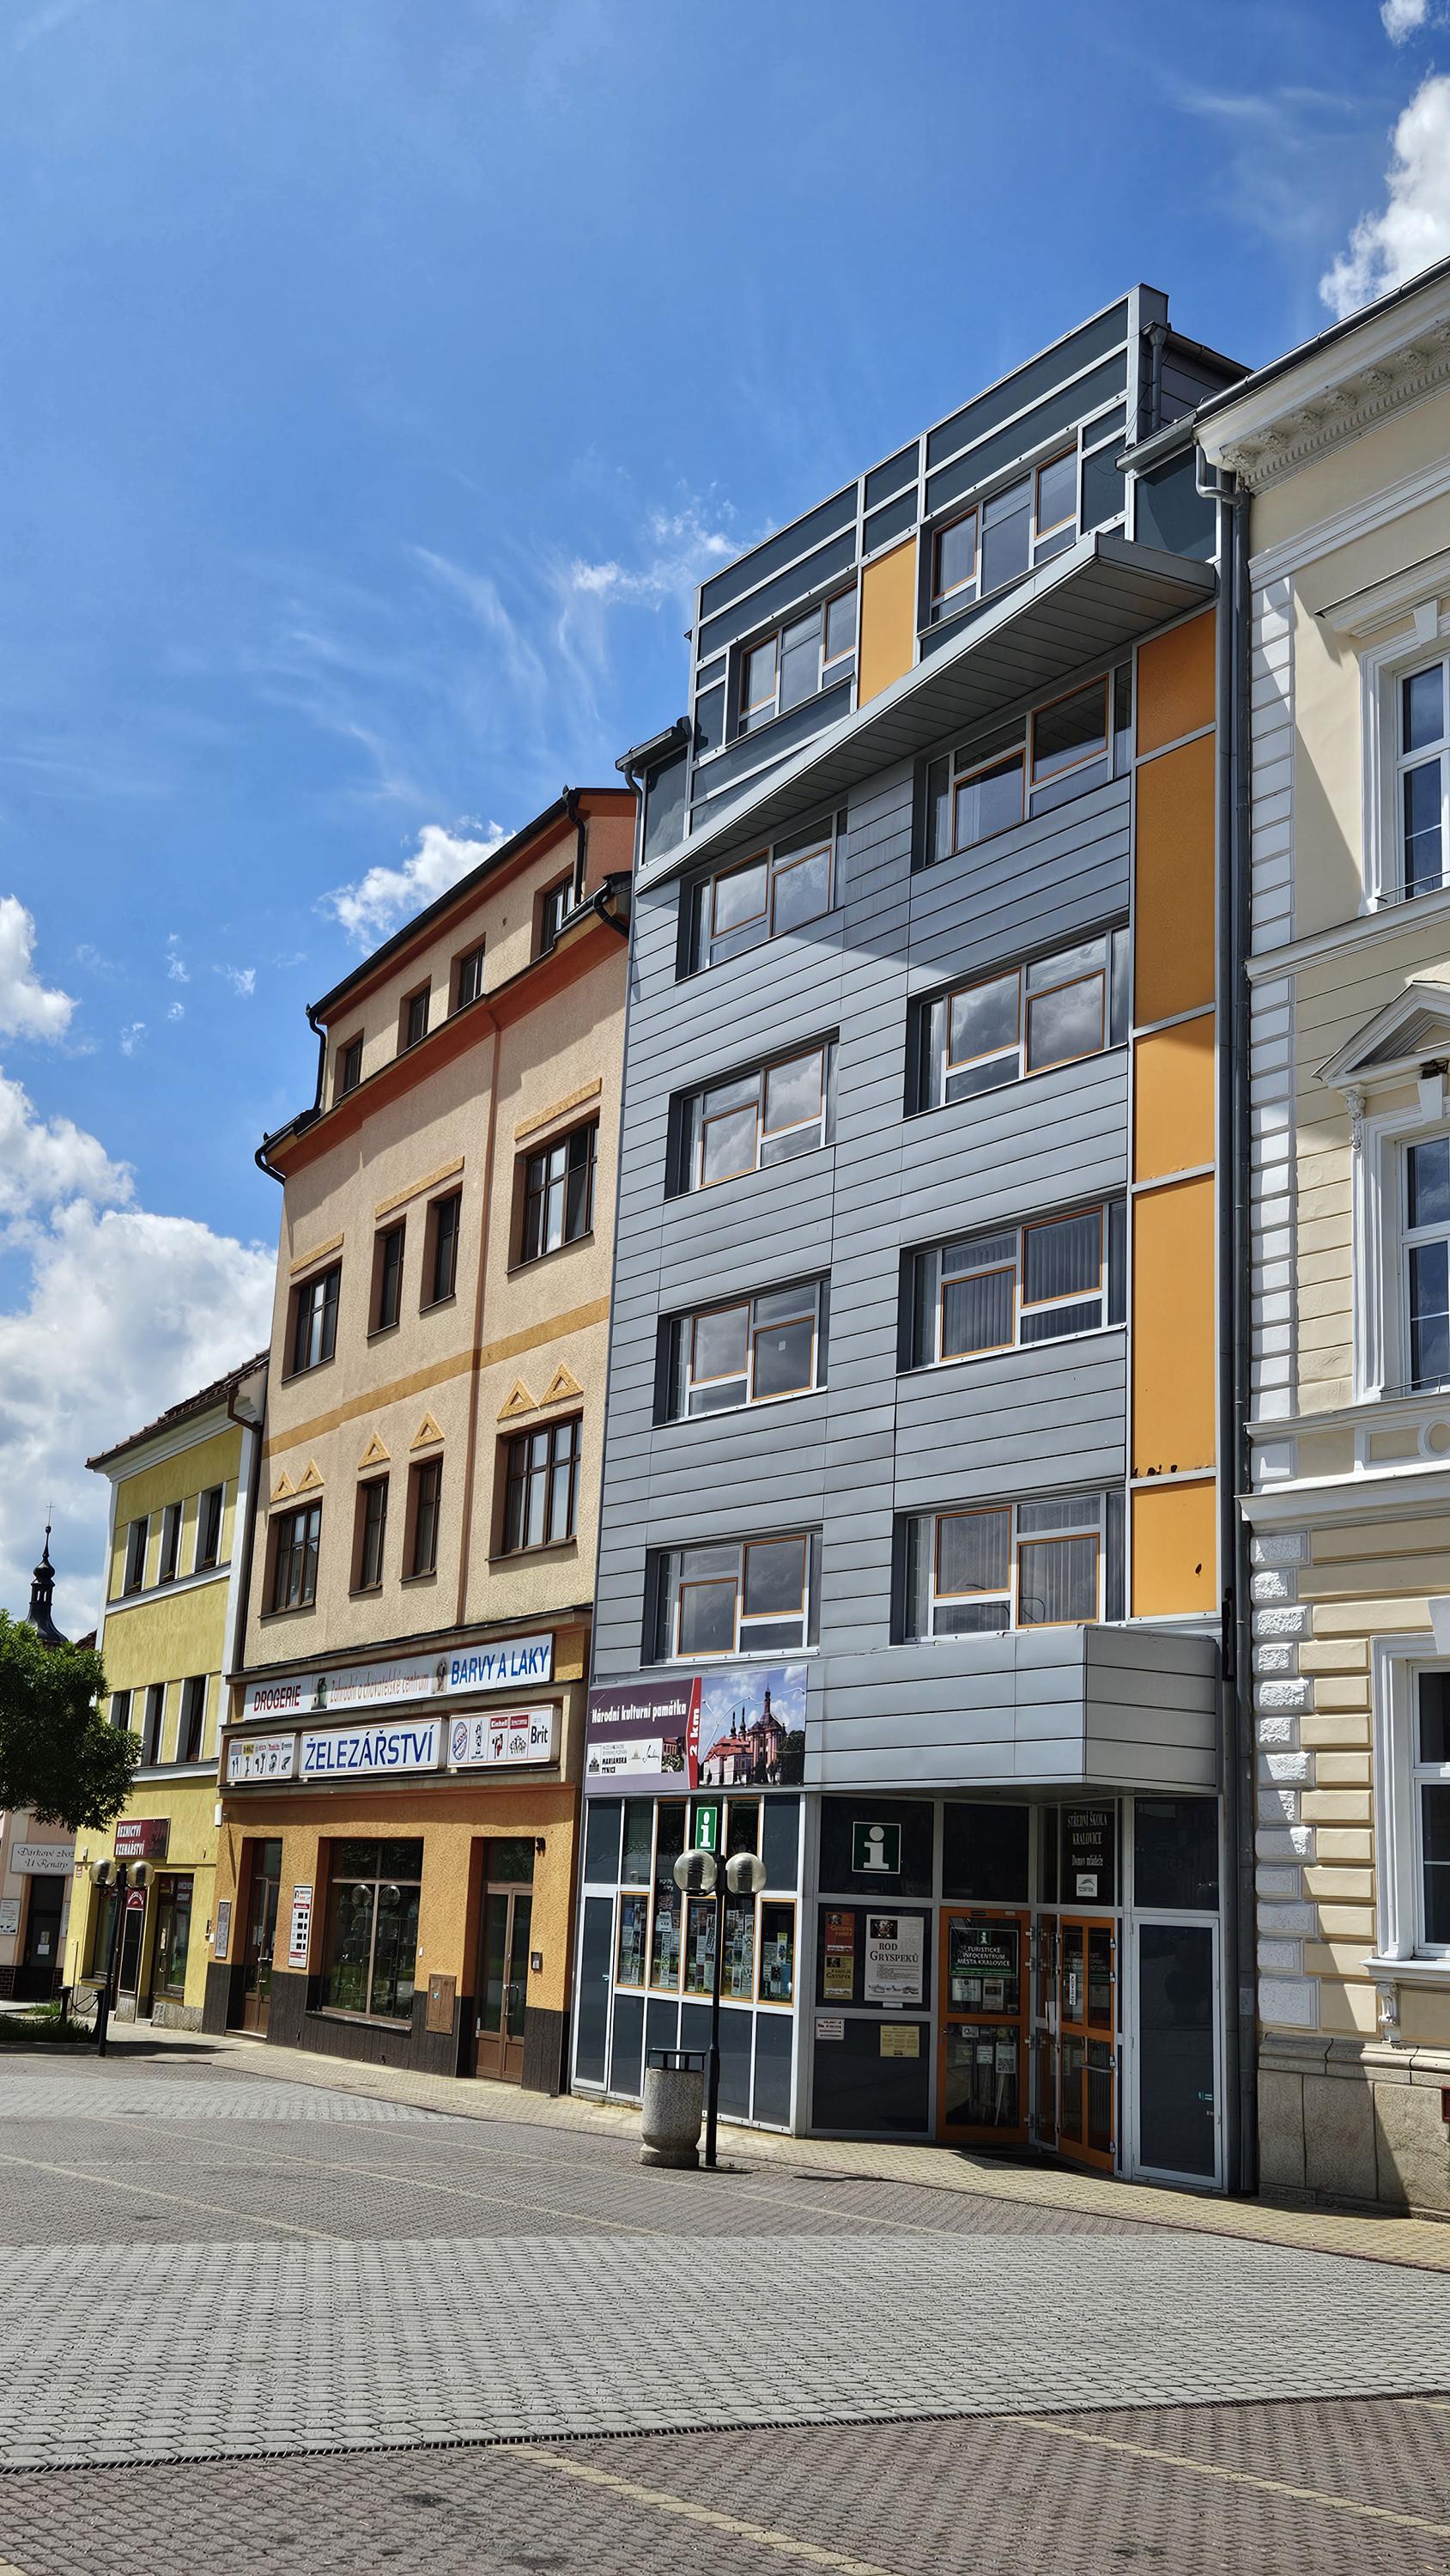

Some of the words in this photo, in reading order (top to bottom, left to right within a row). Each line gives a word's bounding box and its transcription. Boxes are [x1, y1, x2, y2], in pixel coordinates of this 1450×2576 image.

[452, 1655, 495, 1685] BARVY
[497, 1652, 507, 1679] A
[511, 1645, 549, 1676] LAKY
[403, 1670, 429, 1694] centrum
[254, 1685, 301, 1711] DROGERIE
[592, 1704, 621, 1723] Národní
[621, 1702, 652, 1721] kulturní
[652, 1698, 687, 1722] památka
[689, 1708, 700, 1738] km
[531, 1725, 548, 1744] Brit
[305, 1724, 434, 1771] ŽELEZÁŘSTVÍ
[689, 1745, 698, 1757] 2
[1072, 1832, 1102, 1845] KRALOVICE
[17, 1847, 55, 1856] Dárkové
[870, 1950, 919, 1963] GRYSPEKŮ
[878, 1942, 898, 1951] ROD
